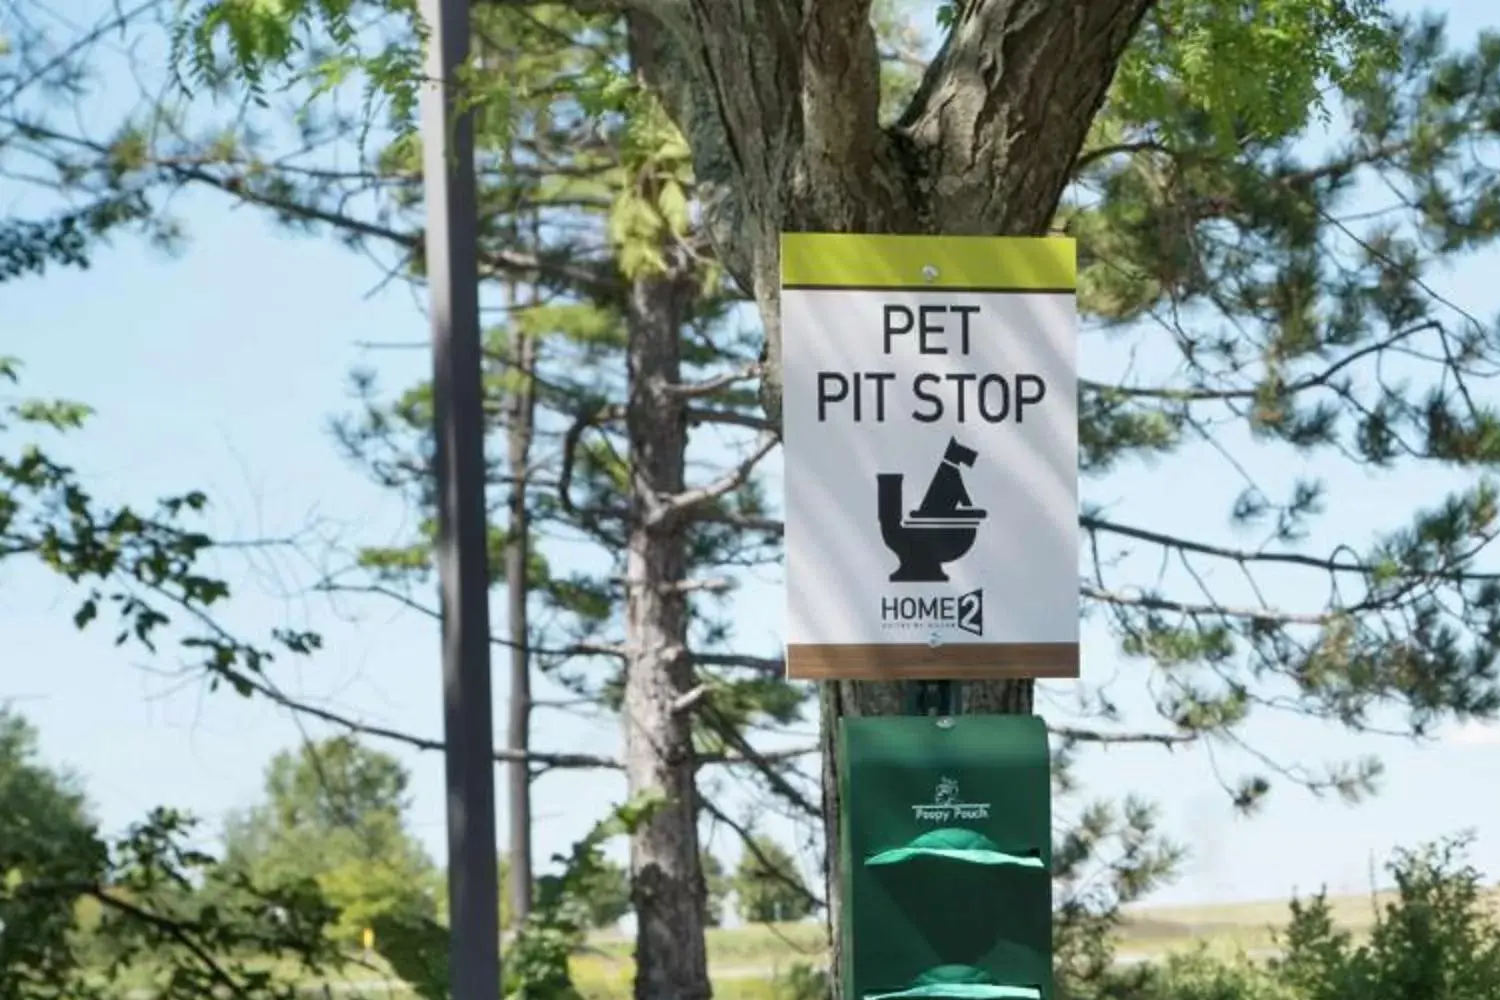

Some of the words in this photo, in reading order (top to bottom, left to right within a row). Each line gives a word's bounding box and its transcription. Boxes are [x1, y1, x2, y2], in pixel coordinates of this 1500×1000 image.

[883, 304, 981, 355] PET
[817, 371, 897, 423] PIT
[912, 373, 1046, 424] STOP
